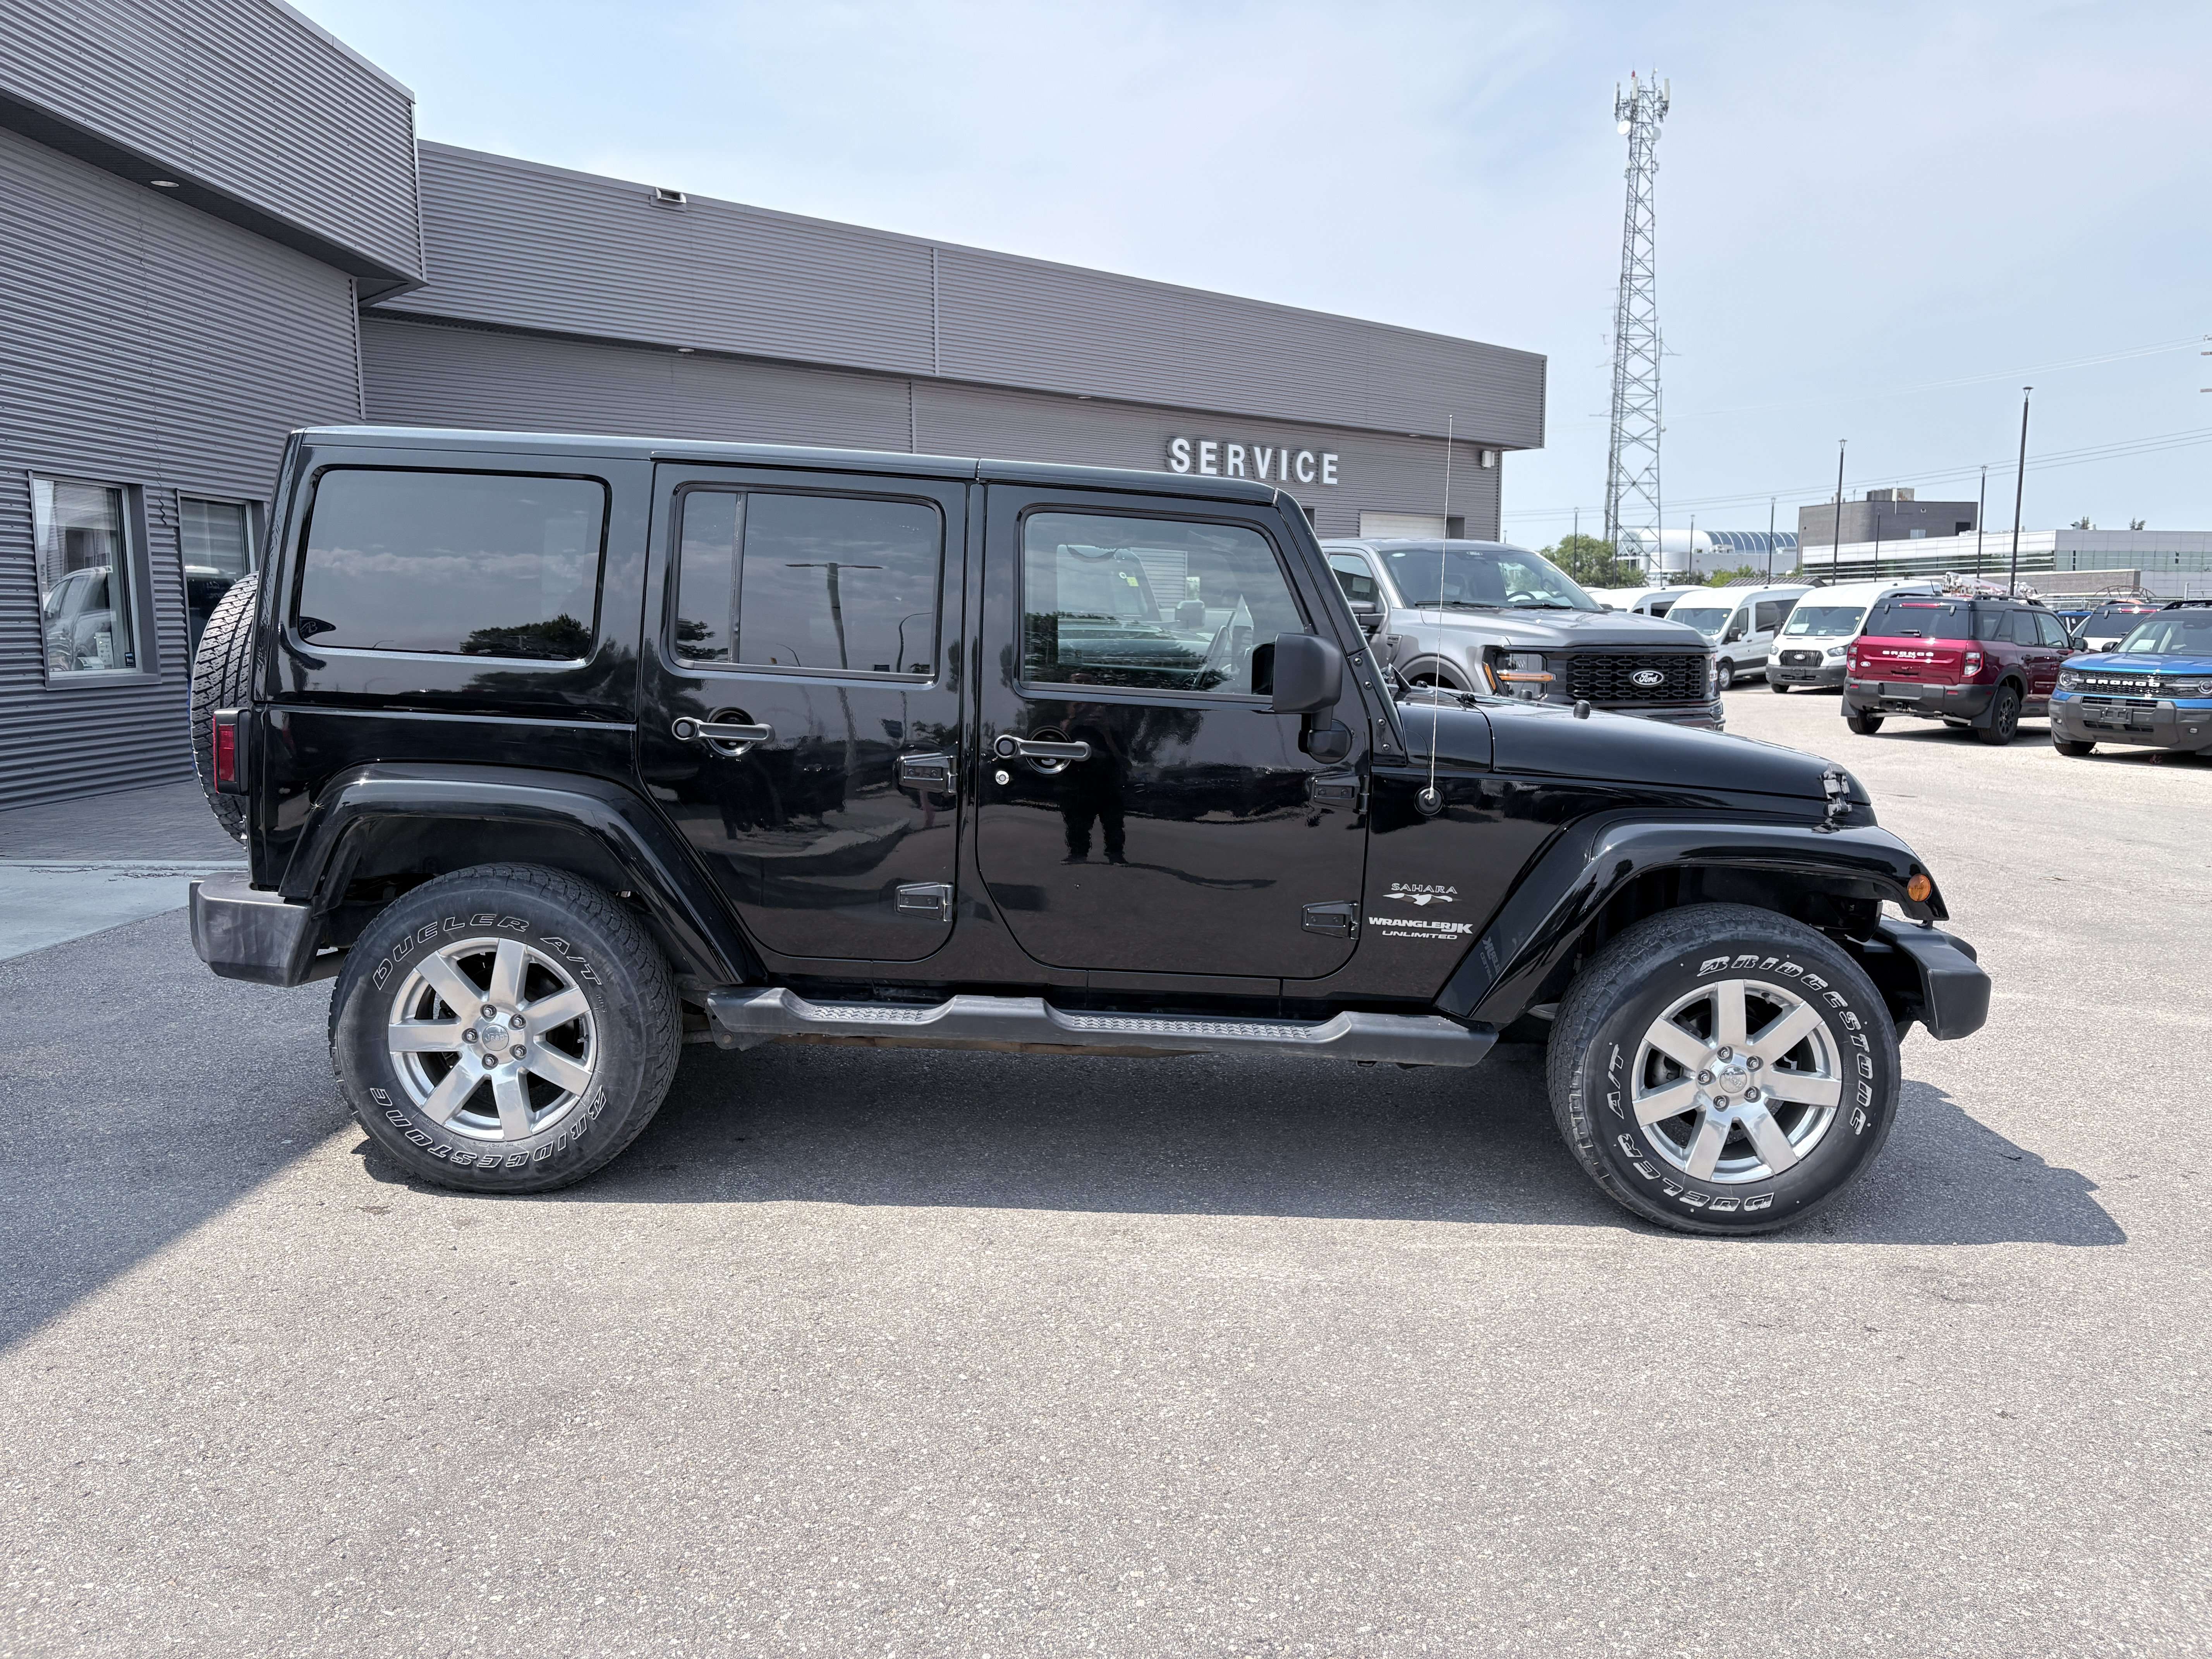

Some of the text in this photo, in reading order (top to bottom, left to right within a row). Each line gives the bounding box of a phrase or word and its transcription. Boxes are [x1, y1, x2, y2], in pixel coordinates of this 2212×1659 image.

[1168, 438, 1338, 485] SERVICE
[1638, 672, 1659, 683] Ford
[2086, 678, 2160, 687] BRONCO
[1391, 883, 1458, 894] SAHARA
[373, 913, 603, 991] DUELER A/T
[1382, 930, 1458, 940] UNLIMITED
[1697, 955, 1873, 1135] BRIDGESTONE
[370, 1085, 607, 1168] BRIDGESTONE
[1608, 1044, 1775, 1212] DUELER A/T
